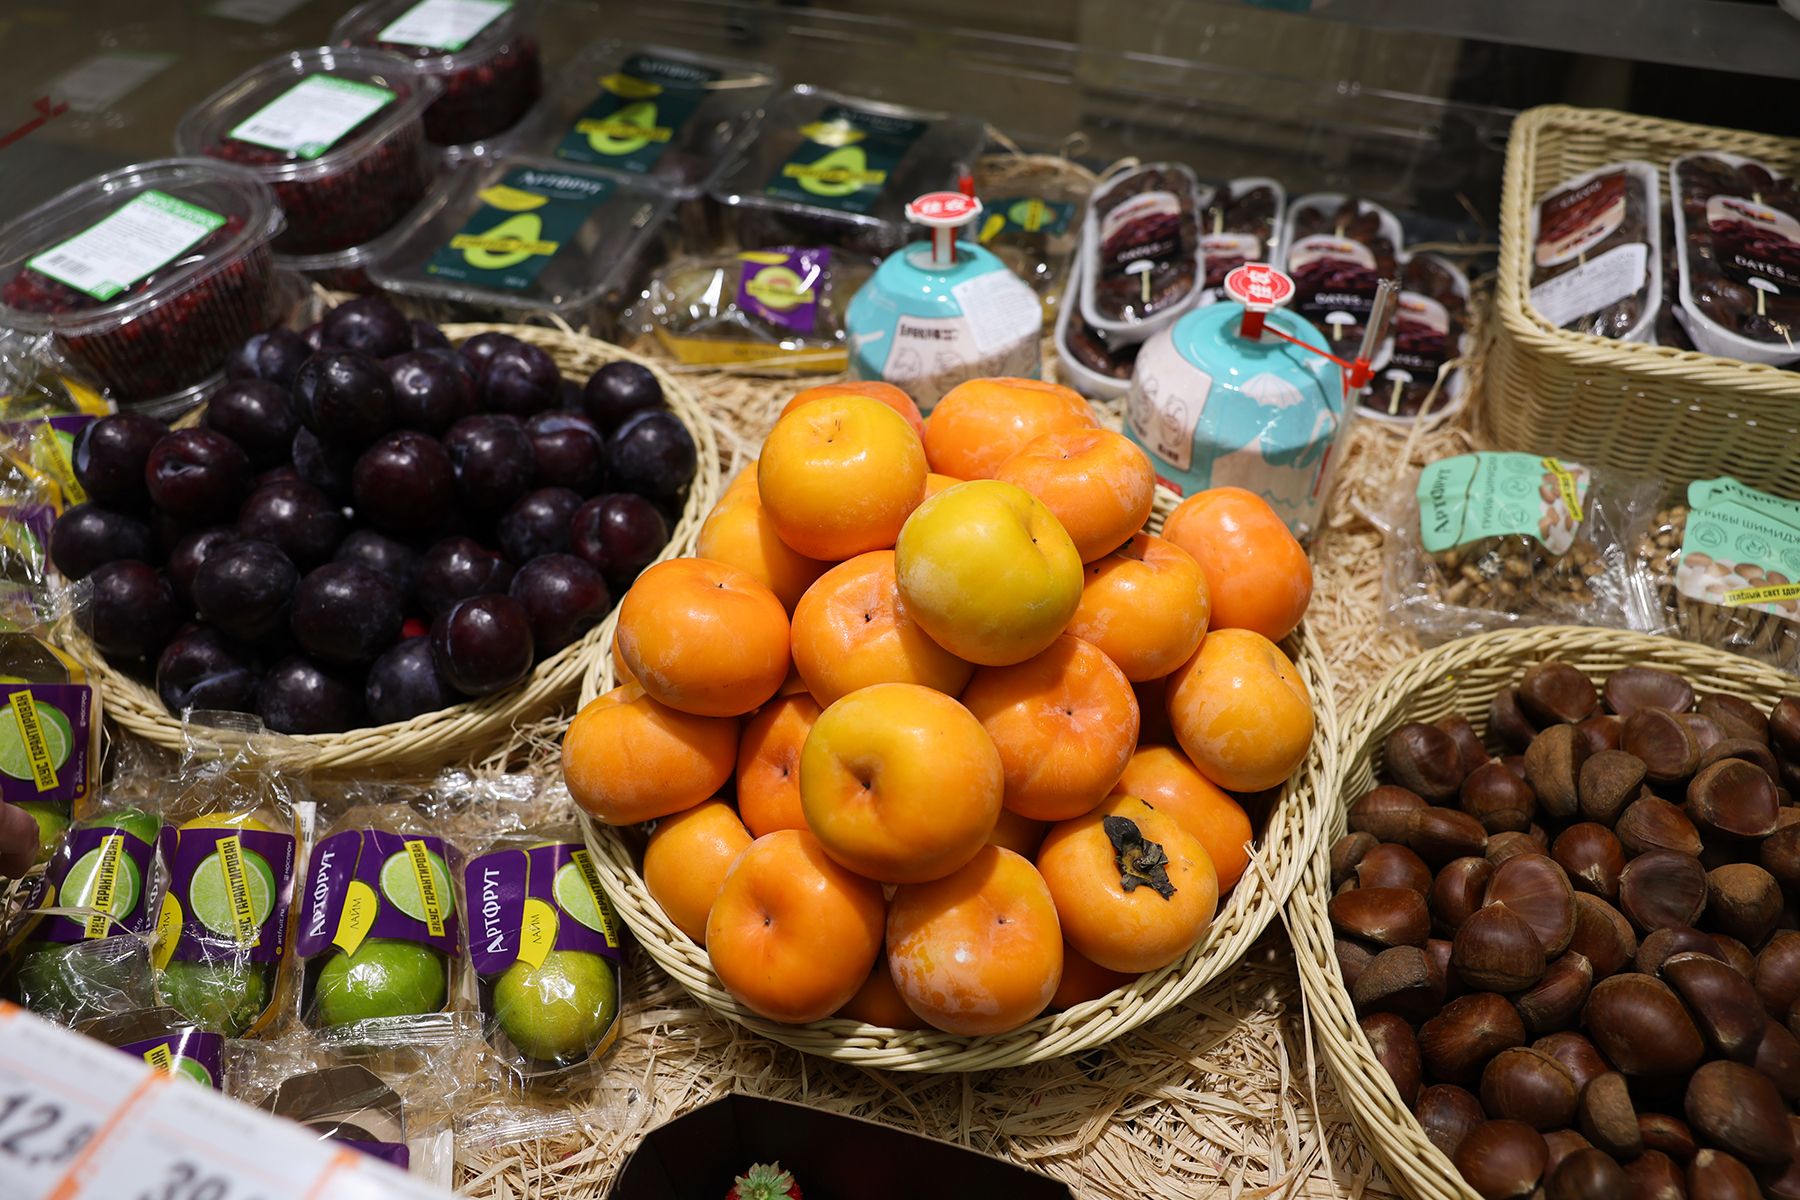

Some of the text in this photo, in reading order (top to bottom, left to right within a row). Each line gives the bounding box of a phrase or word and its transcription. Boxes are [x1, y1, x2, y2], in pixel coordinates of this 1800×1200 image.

[1735, 255, 1785, 277] DATES
[15, 694, 54, 786] ВКУС ГАРАНТИРОВАН
[222, 840, 250, 915] ГАРАНТИРОВАН
[309, 850, 336, 937] АРТФРУТ
[410, 843, 442, 933] ВКУС ГАРАНТИРОВАН
[277, 908, 285, 945] artfruit.ru
[350, 897, 362, 930] ЛАЙМ
[482, 867, 508, 954] АРТФРУТ
[529, 913, 542, 945] ЛАЙМ
[603, 917, 617, 944] ВКУС
